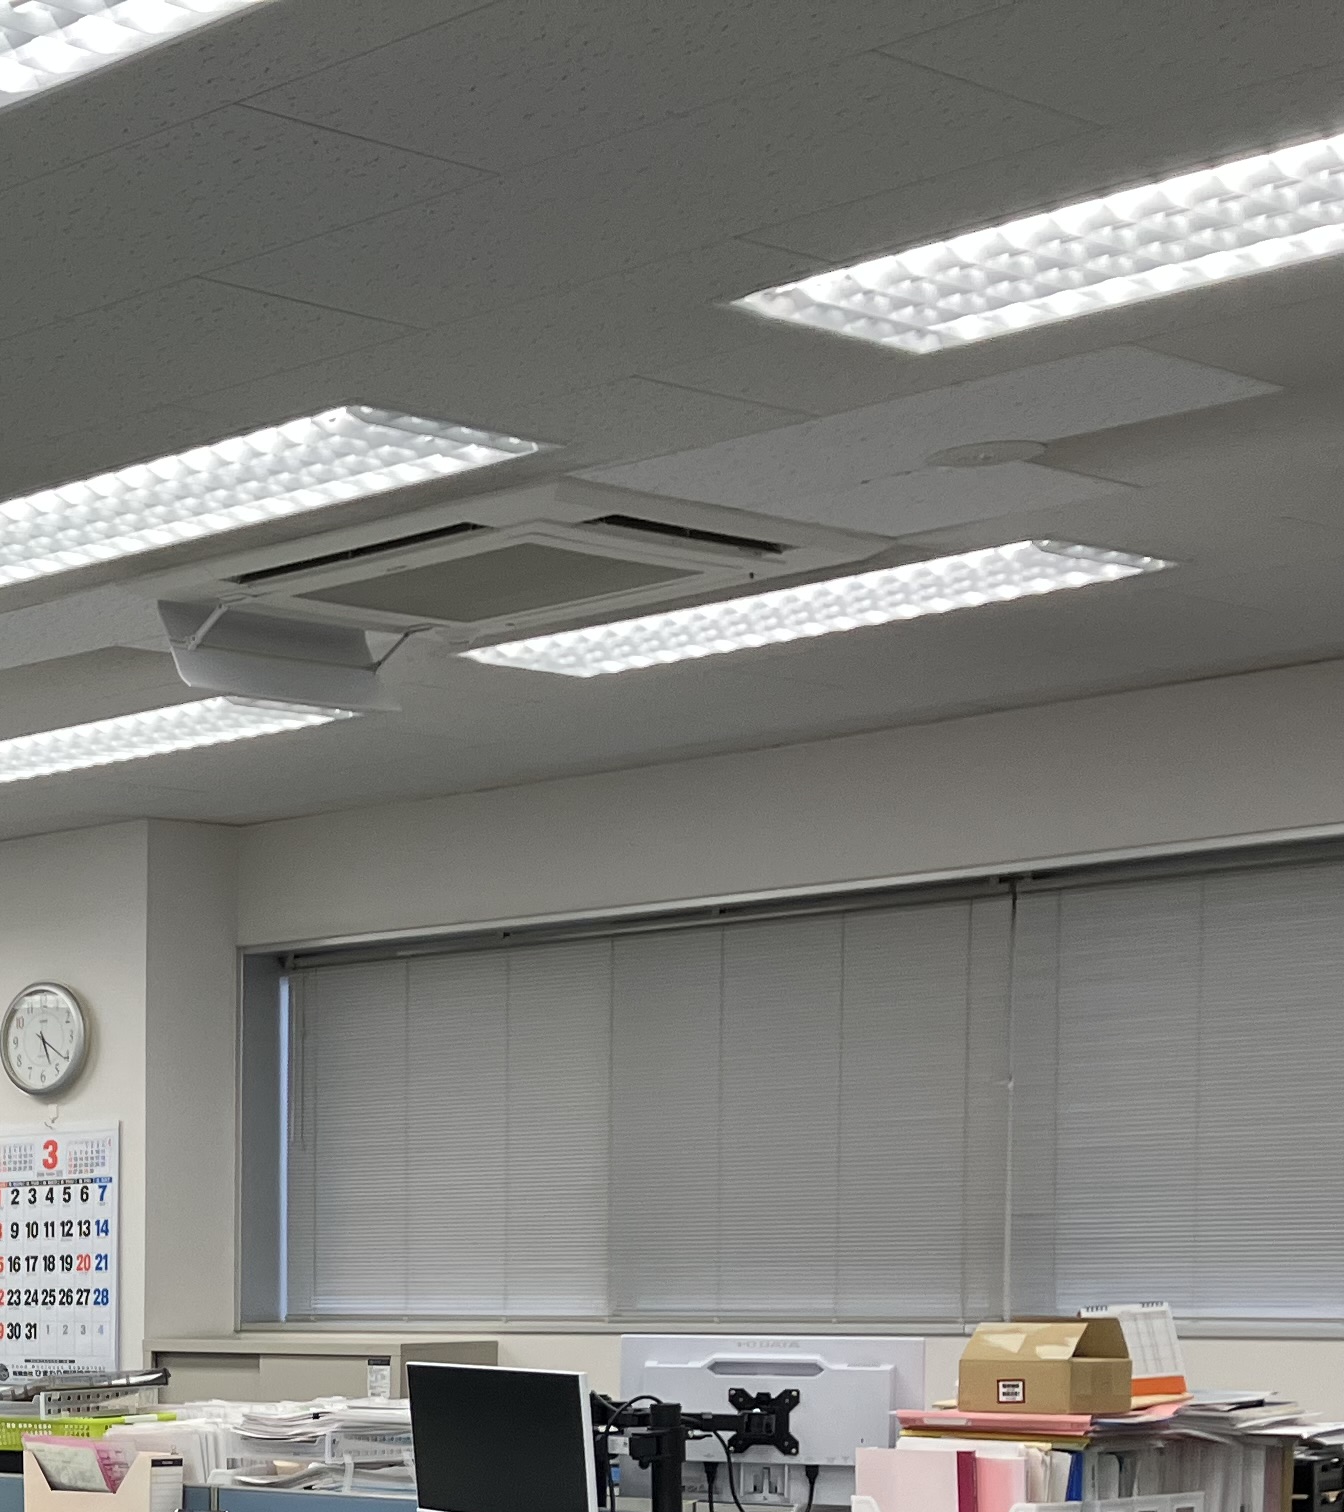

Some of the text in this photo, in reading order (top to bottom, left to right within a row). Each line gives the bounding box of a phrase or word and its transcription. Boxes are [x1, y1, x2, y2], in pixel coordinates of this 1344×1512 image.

[16, 1016, 24, 1029] 10
[13, 1036, 18, 1049] 9
[17, 1054, 22, 1067] 8
[28, 1066, 32, 1079] 7
[41, 1070, 46, 1082] 6
[43, 1140, 58, 1170] 3
[11, 1189, 19, 1205] 2
[28, 1188, 36, 1204] 3
[45, 1187, 54, 1203] 4
[63, 1186, 71, 1203] 5
[81, 1186, 89, 1202] 6
[98, 1185, 107, 1202] 7
[11, 1222, 19, 1239] 9
[26, 1221, 38, 1238] 10
[44, 1221, 54, 1238] 11
[60, 1220, 73, 1237] 12
[77, 1220, 90, 1237] 13
[95, 1219, 109, 1236] 14
[8, 1256, 20, 1272] 16
[25, 1255, 38, 1272] 17
[43, 1255, 55, 1272] 18
[60, 1254, 73, 1271] 19
[76, 1254, 91, 1271] 20
[95, 1254, 108, 1271] 21
[7, 1289, 21, 1306] 23
[24, 1289, 38, 1305] 24
[42, 1289, 55, 1305] 25
[59, 1288, 73, 1305] 26
[76, 1289, 90, 1305] 27
[94, 1288, 109, 1305] 28
[7, 1322, 21, 1339] 30
[25, 1323, 36, 1339] 31
[63, 1325, 68, 1335] 2
[81, 1325, 86, 1335] 3
[98, 1325, 103, 1335] 4
